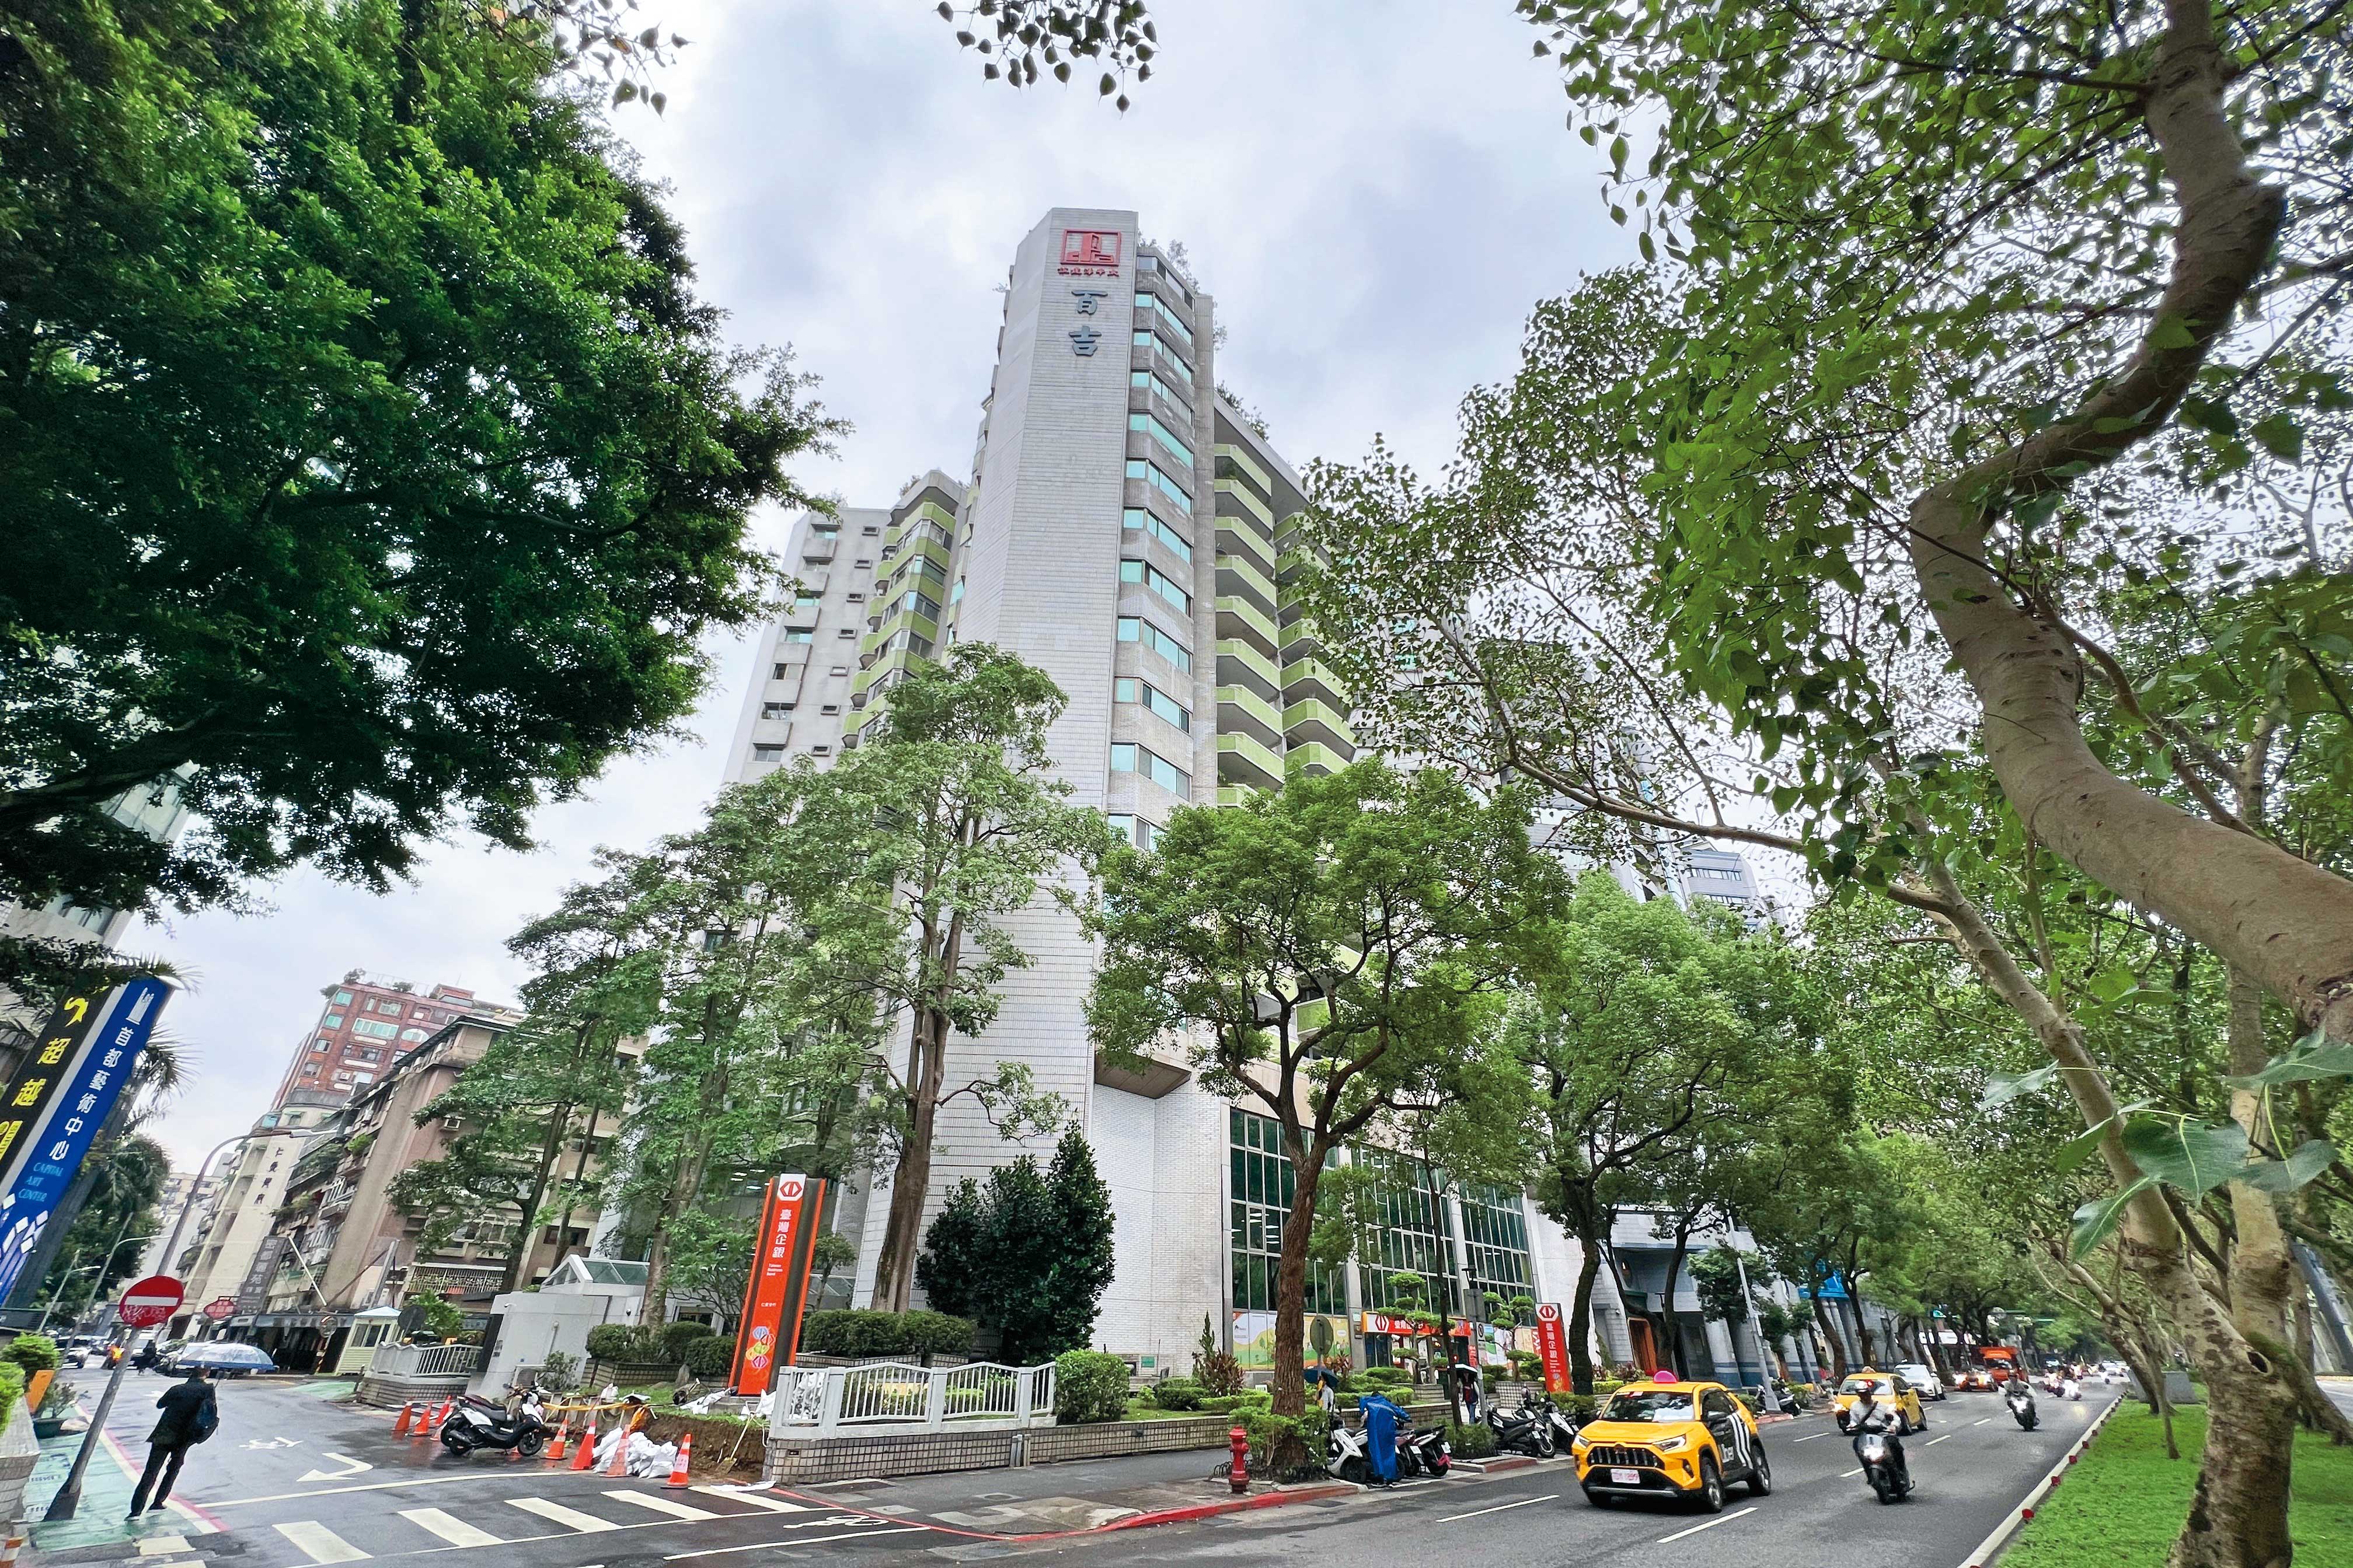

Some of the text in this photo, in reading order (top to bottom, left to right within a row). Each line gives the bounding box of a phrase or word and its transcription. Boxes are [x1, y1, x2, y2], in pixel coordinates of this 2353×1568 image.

[49, 1026, 134, 1160] 首都藝術中心
[33, 1162, 64, 1176] CAPITAL
[26, 1176, 44, 1186] ART
[18, 1188, 47, 1202] CENTER
[772, 1209, 792, 1258] 臺灣企銀
